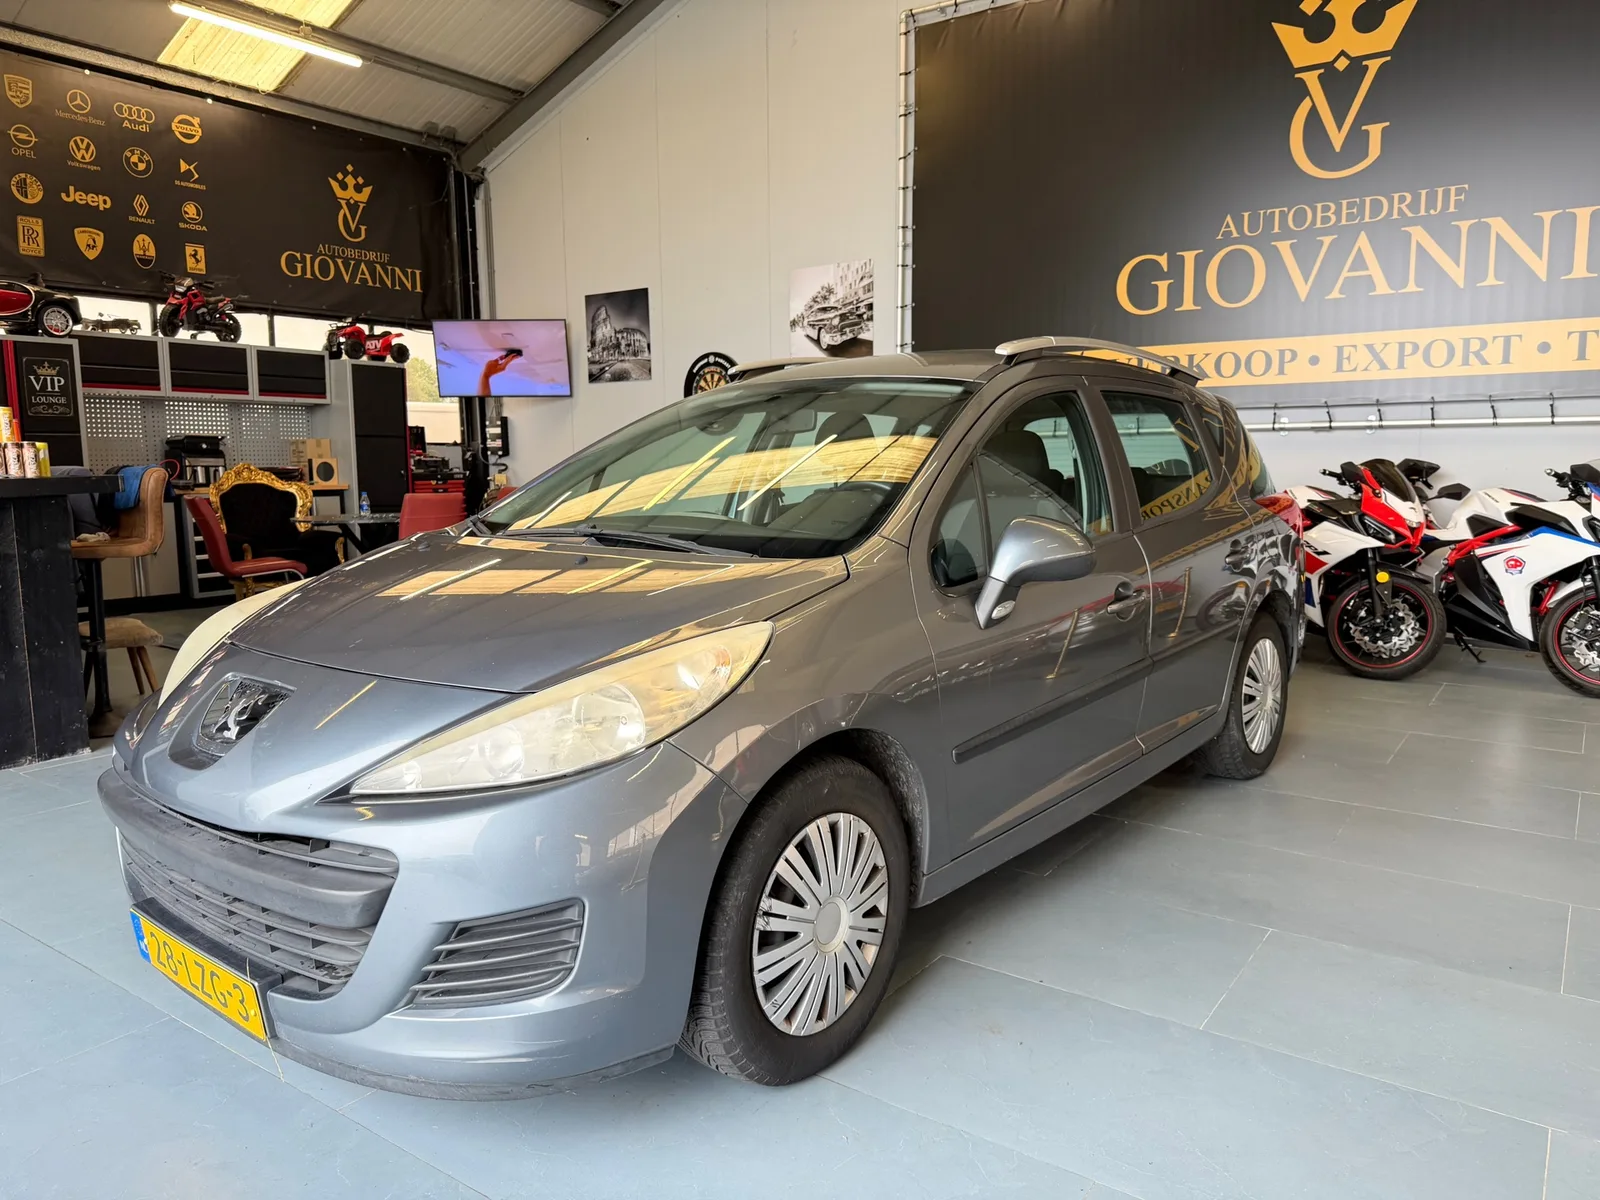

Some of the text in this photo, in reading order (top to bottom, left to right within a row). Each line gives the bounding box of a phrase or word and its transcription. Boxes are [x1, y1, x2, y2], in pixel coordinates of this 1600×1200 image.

[122, 119, 150, 133] Audi
[175, 125, 200, 133] VOLVO
[11, 147, 37, 159] OPEL
[125, 149, 151, 161] BMW
[66, 159, 101, 172] Volkswagen
[60, 185, 112, 211] Jeep
[1215, 184, 1470, 240] AUTOBEDRIJF
[19, 217, 40, 225] ROLLS
[128, 215, 156, 225] RENAULT
[21, 247, 42, 255] ROYCE
[316, 243, 391, 264] AUTOBEDRIJF
[1115, 205, 1600, 316] GIOVANNI
[280, 250, 424, 293] GIOVANNI
[365, 340, 382, 351] ATV
[1110, 348, 1299, 380] KOOP
[1331, 333, 1523, 374] EXPORT
[28, 375, 65, 392] VIP
[31, 395, 67, 404] LOUNGE
[150, 931, 250, 1023] 28-LZG-3
